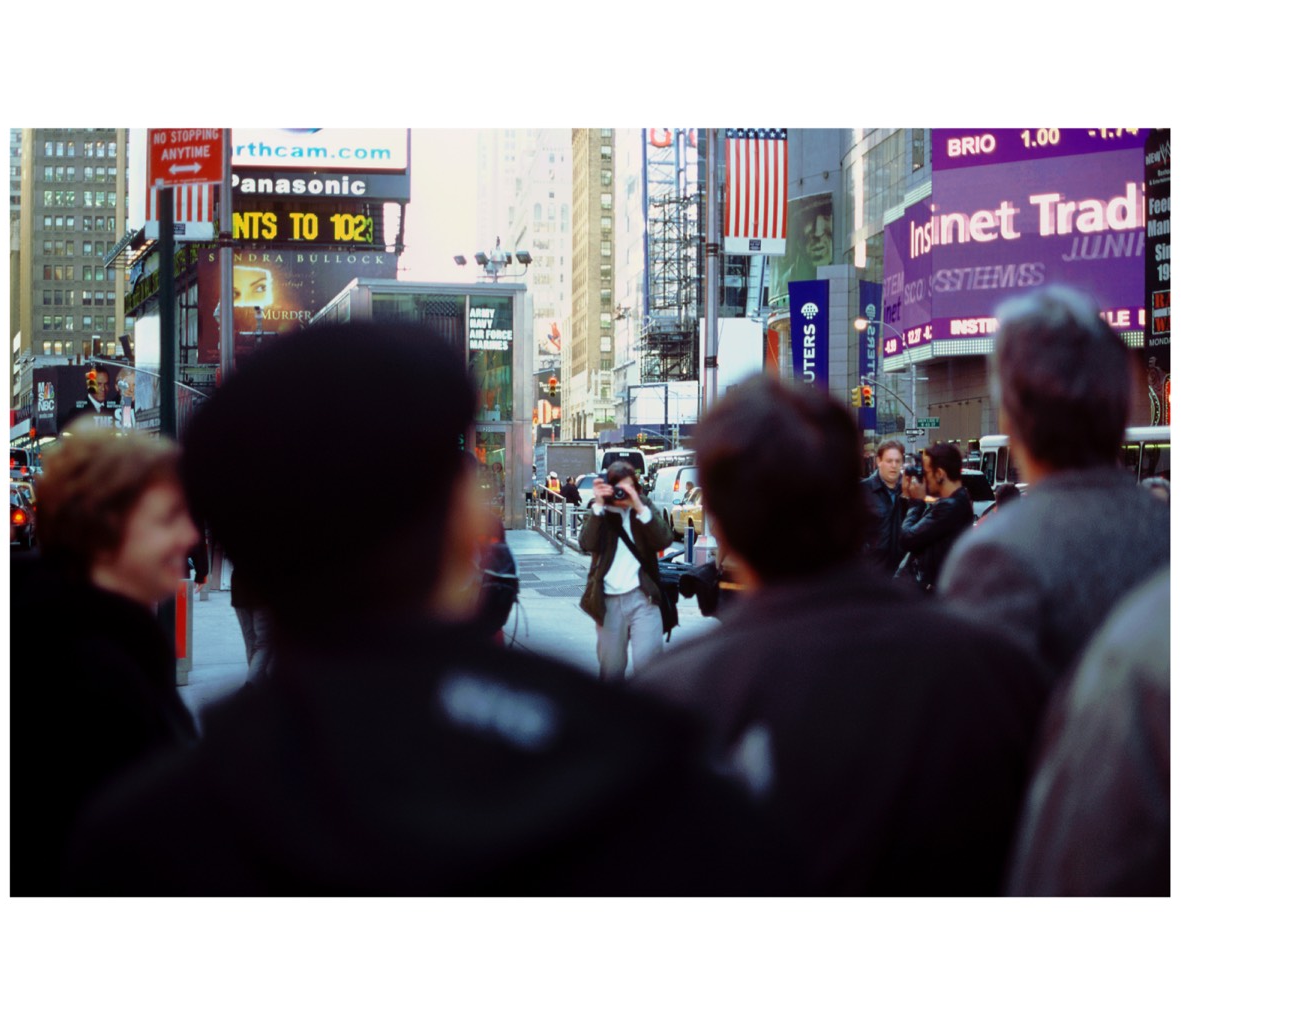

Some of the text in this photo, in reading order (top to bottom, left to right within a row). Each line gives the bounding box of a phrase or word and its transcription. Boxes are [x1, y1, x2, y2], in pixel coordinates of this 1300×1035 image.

[153, 128, 219, 145] NO STOPPING
[947, 134, 996, 157] BRIO
[1020, 129, 1060, 148] 1.00
[161, 145, 211, 161] ANYTIME
[231, 142, 391, 160] rthcam.com
[1029, 182, 1145, 236] Trad
[288, 212, 319, 241] TO
[208, 252, 385, 264] SNDRA BULLOCK
[1156, 262, 1171, 282] 19
[261, 309, 312, 321] MURDER
[470, 307, 495, 318] ARMY
[470, 318, 493, 329] NAVY
[470, 329, 513, 341] AIR FORCE
[469, 340, 509, 351] MARINES
